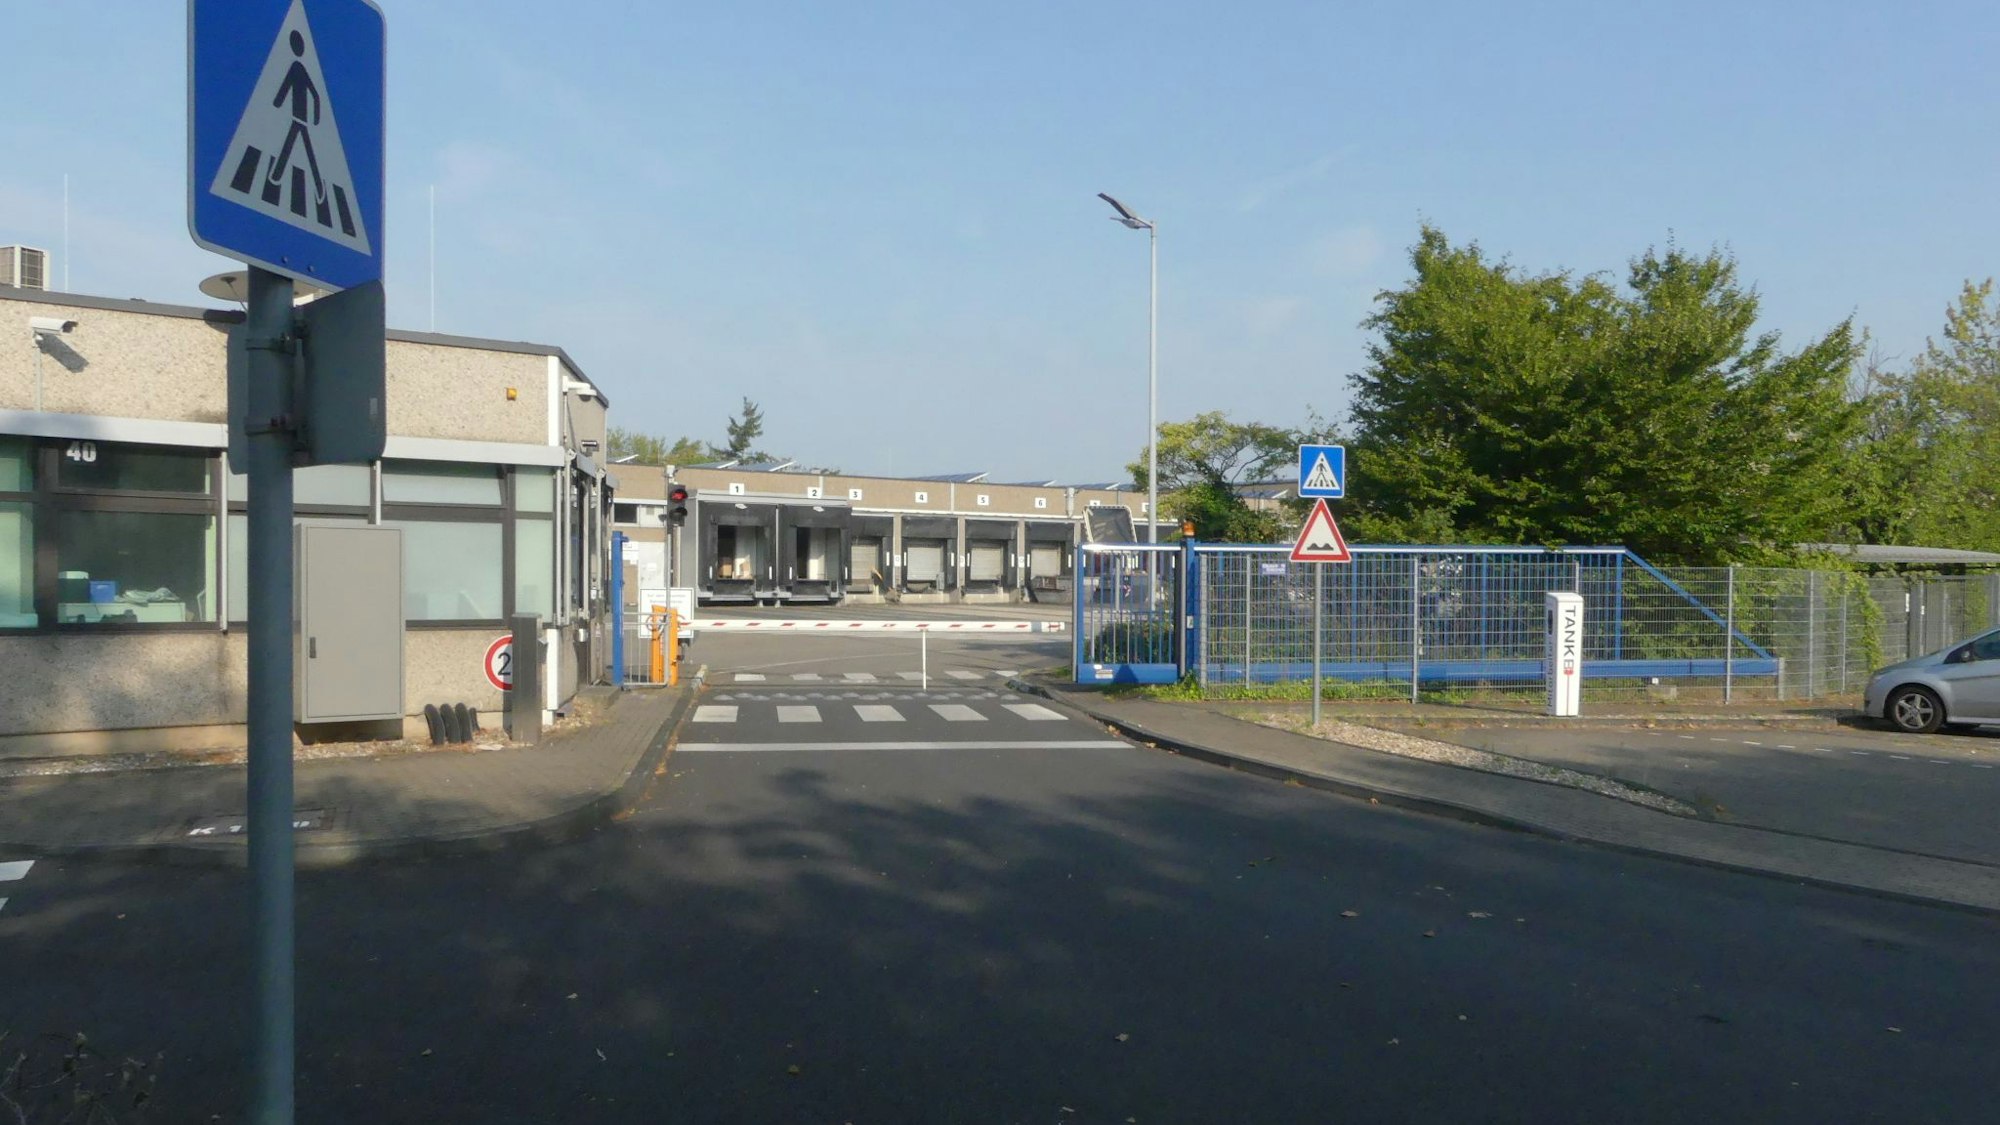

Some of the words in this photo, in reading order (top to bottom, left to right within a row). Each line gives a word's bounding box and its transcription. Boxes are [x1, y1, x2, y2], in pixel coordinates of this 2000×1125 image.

[66, 440, 97, 463] 40
[812, 489, 818, 497] 2
[498, 652, 511, 676] 2
